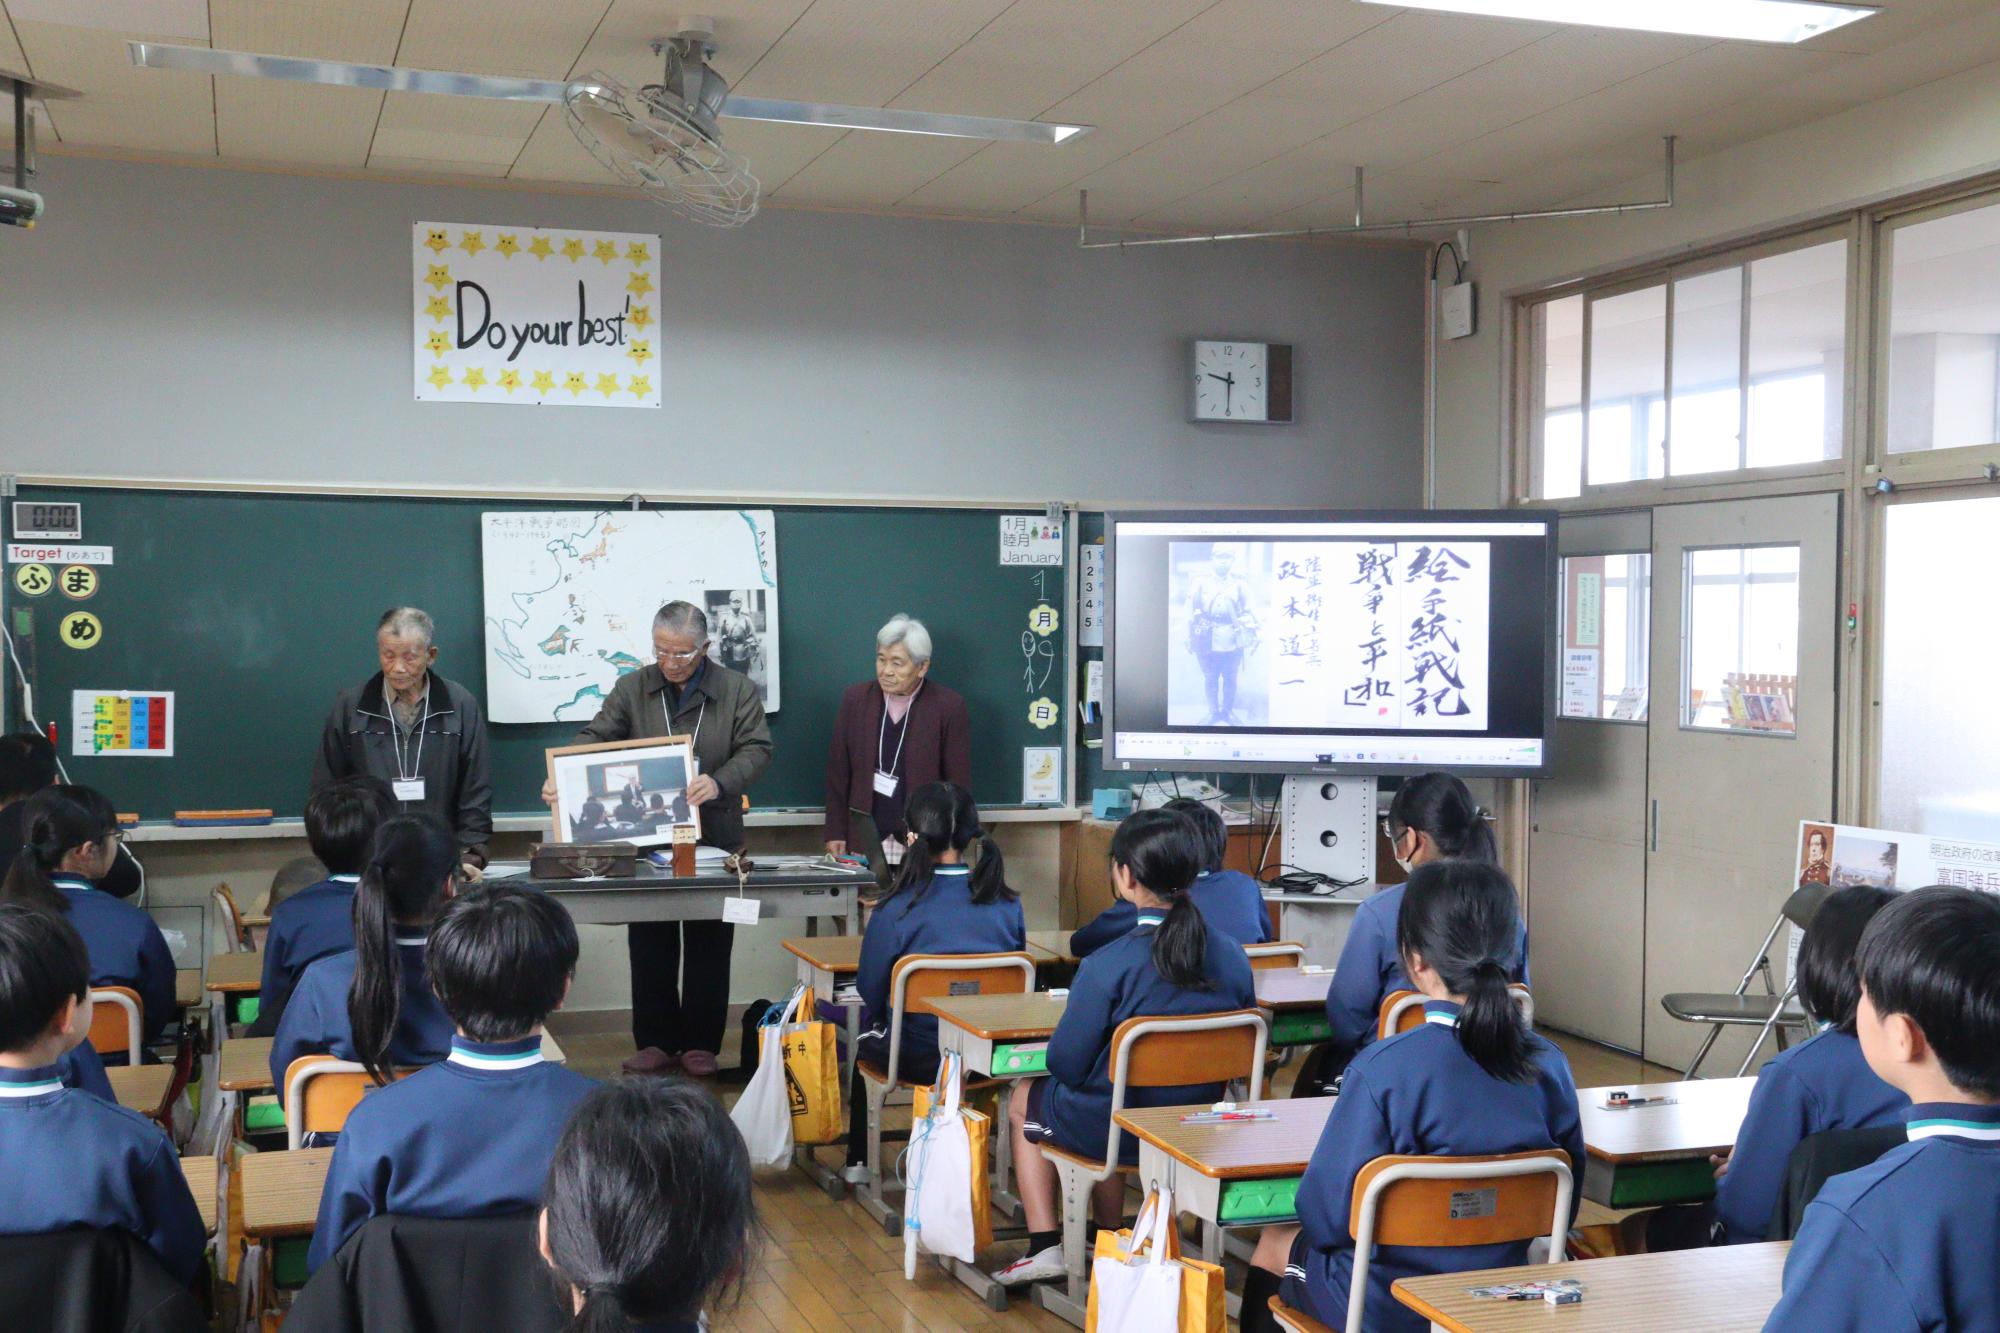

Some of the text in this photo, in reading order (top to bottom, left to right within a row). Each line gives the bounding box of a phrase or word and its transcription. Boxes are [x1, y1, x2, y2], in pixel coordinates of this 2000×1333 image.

[456, 279, 631, 362] Do your best!
[1223, 345, 1233, 356] 12
[1195, 374, 1203, 385] 9
[1254, 377, 1262, 387] 3
[1003, 517, 1027, 532] 1月
[1002, 533, 1030, 548] 睦月
[12, 546, 62, 560] Target
[1002, 550, 1061, 565] January
[1086, 550, 1092, 561] 1
[1087, 566, 1094, 577] 2
[21, 566, 90, 593] ふ ま
[1085, 582, 1094, 592] 3
[1085, 599, 1093, 609] 4
[1037, 611, 1051, 627] 月
[1084, 617, 1092, 627] 5
[70, 617, 96, 641] め
[1036, 706, 1050, 720] 日
